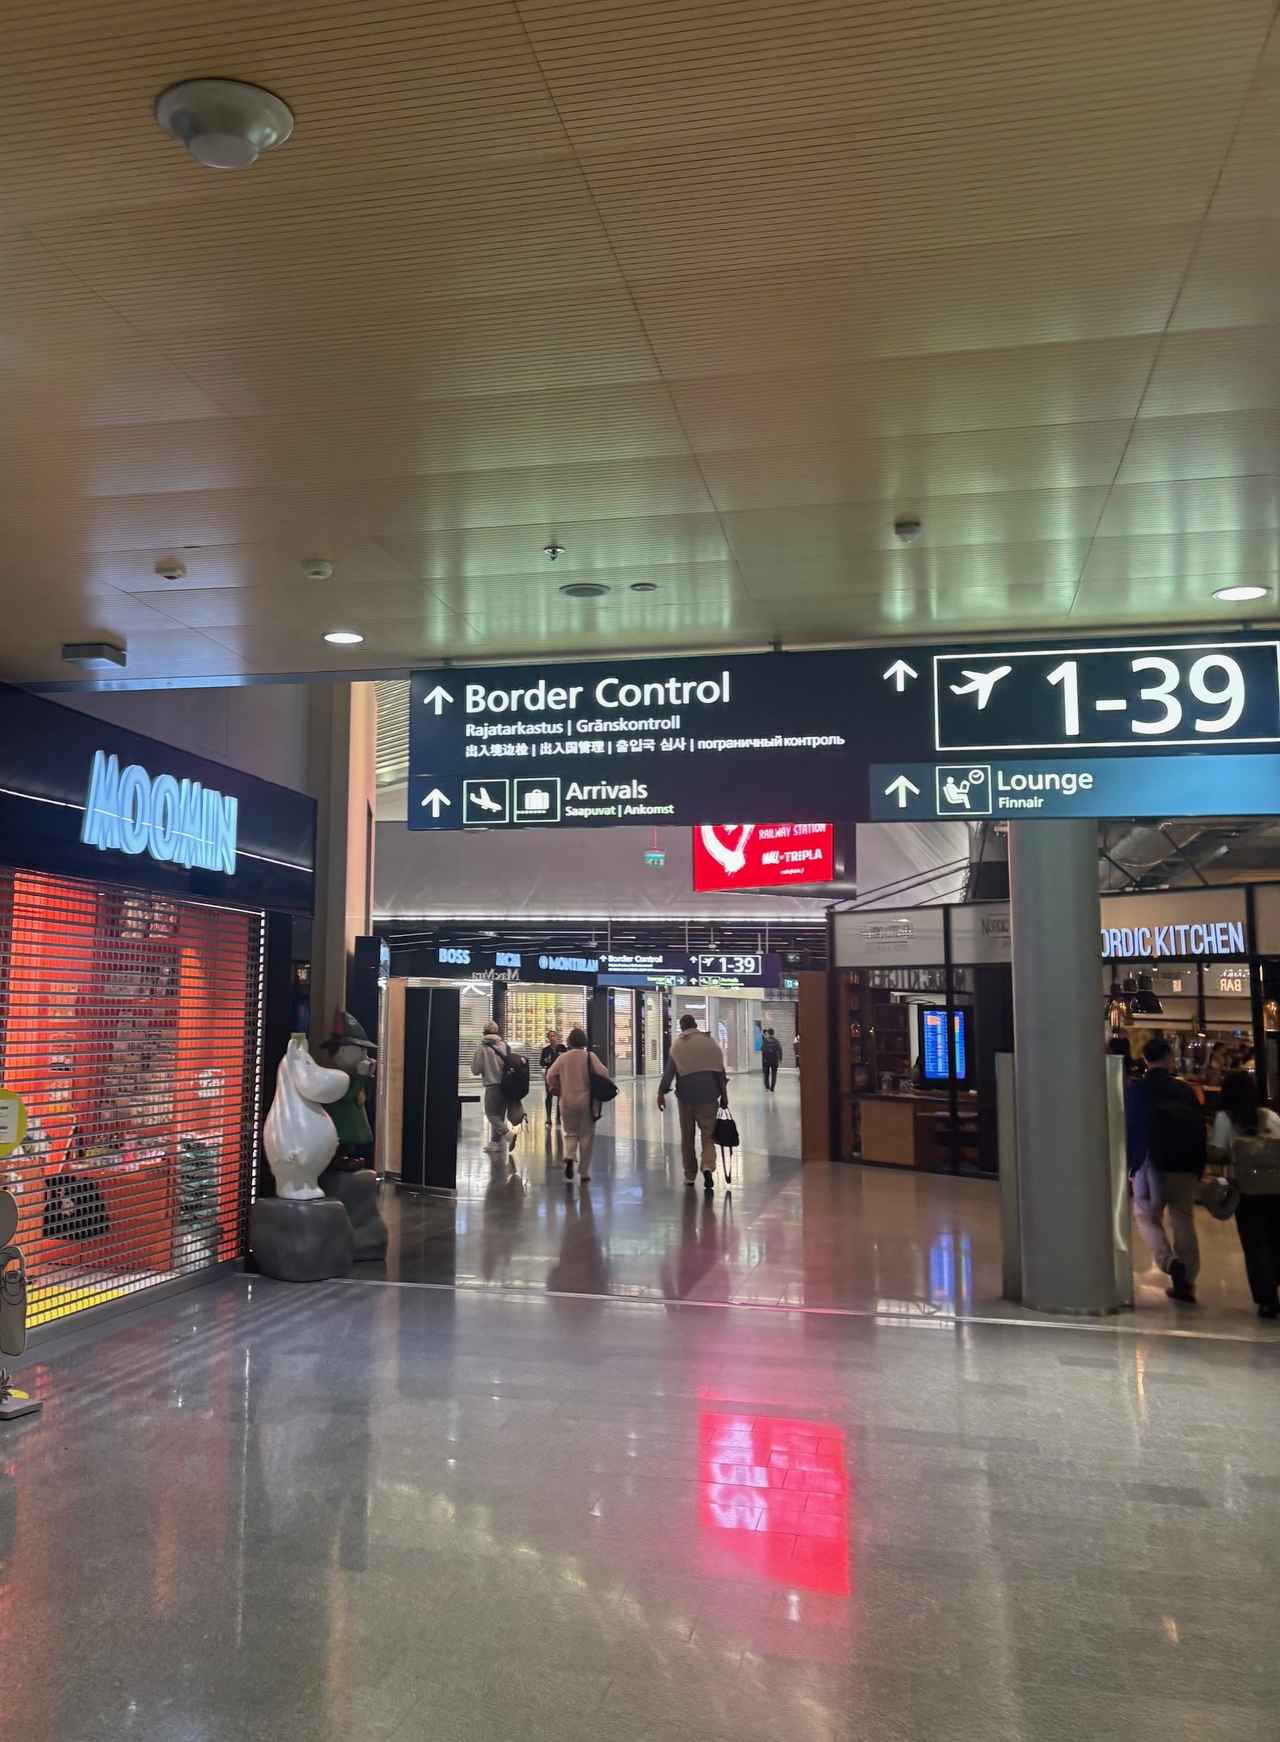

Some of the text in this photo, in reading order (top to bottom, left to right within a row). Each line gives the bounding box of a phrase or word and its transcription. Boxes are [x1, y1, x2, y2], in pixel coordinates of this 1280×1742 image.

[464, 671, 730, 714] Border Control
[1046, 654, 1246, 736] 1-39
[465, 715, 681, 739] Rajatarkastus Gränskontroll
[659, 736, 688, 752] 심사
[697, 734, 846, 752] пограничный контроль
[564, 779, 649, 801] Arrivals
[997, 770, 1094, 795] Lounge
[564, 803, 675, 819] Saapuvat Ankomst
[998, 796, 1045, 809] Finnair
[82, 749, 239, 876] MOOMIN
[758, 823, 827, 840] RAILWAY STATION
[1154, 921, 1247, 956] KITCHEN
[438, 947, 472, 965] BOSS
[608, 955, 664, 964] Border Control
[719, 956, 756, 973] 1-39
